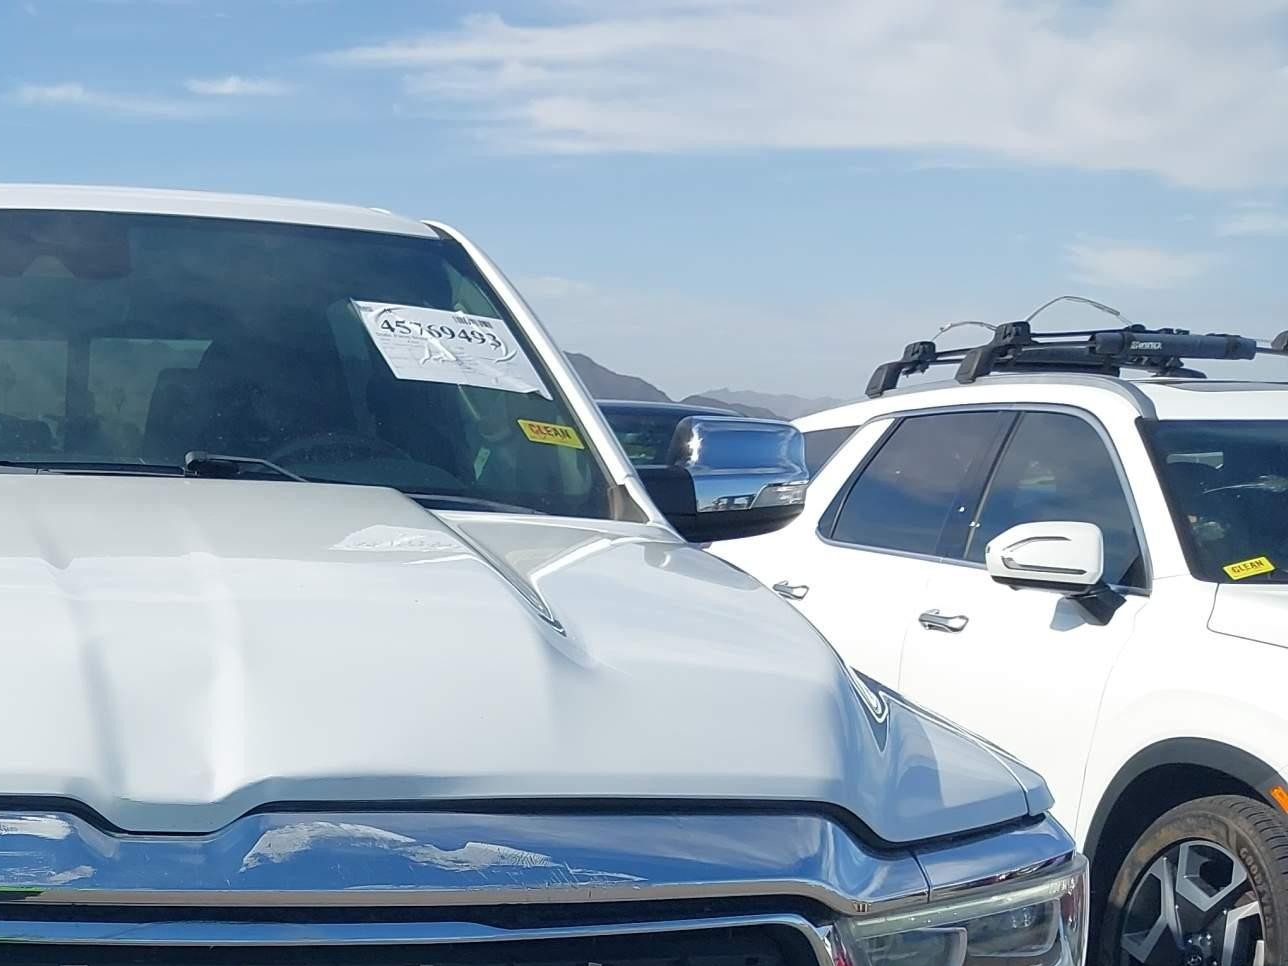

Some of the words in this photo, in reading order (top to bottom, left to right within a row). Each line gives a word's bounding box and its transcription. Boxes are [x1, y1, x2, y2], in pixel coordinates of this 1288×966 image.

[380, 319, 502, 350] 45769493
[528, 423, 572, 439] CLEAN
[1231, 559, 1265, 574] CLEAN
